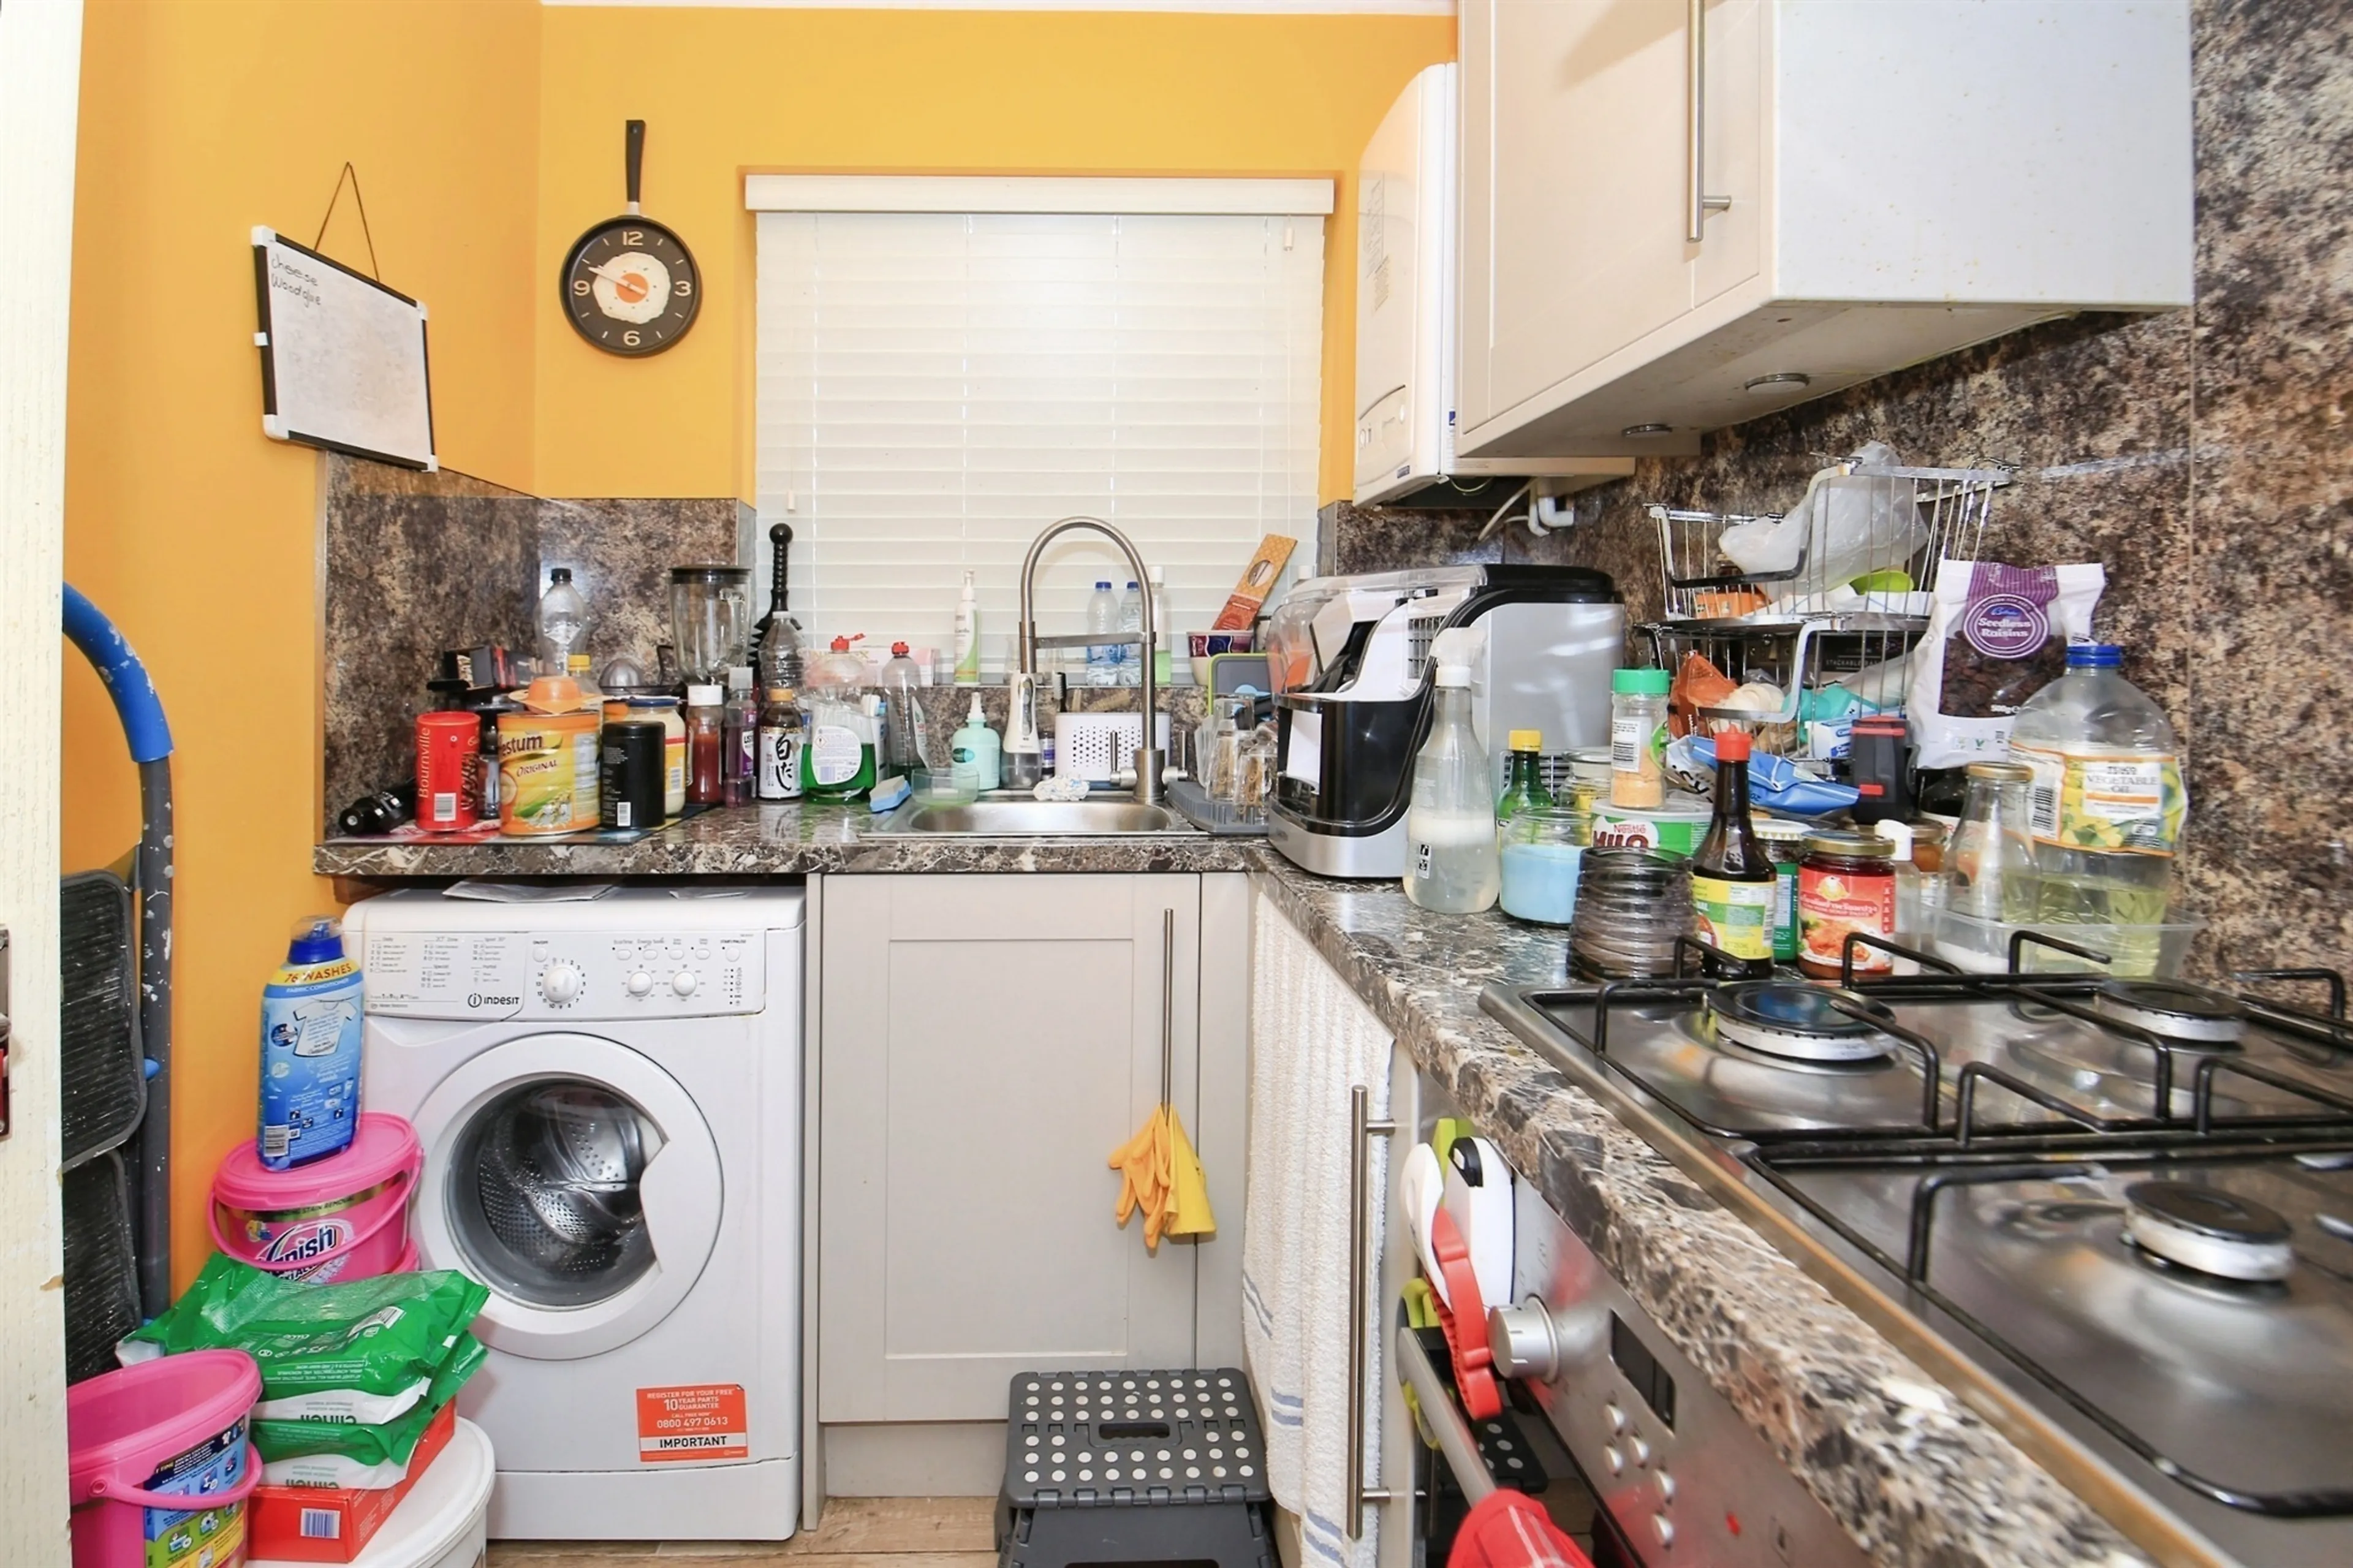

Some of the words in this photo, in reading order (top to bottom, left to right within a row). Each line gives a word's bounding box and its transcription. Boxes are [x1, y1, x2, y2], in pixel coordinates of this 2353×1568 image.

[623, 231, 643, 246] 12
[574, 280, 590, 296] 9
[675, 281, 692, 297] 3
[623, 330, 641, 346] 6
[1978, 618, 2031, 627] Seedless
[1981, 628, 2029, 637] Raisins
[498, 734, 542, 756] estum
[419, 727, 430, 798] Bournville
[2086, 775, 2159, 786] VEGETABLE
[303, 963, 352, 981] WASHES
[664, 1398, 678, 1411] 10
[657, 1419, 681, 1428] 0800
[683, 1418, 702, 1427] 497
[704, 1417, 728, 1426] 0613
[659, 1436, 727, 1448] IMPORTANT
